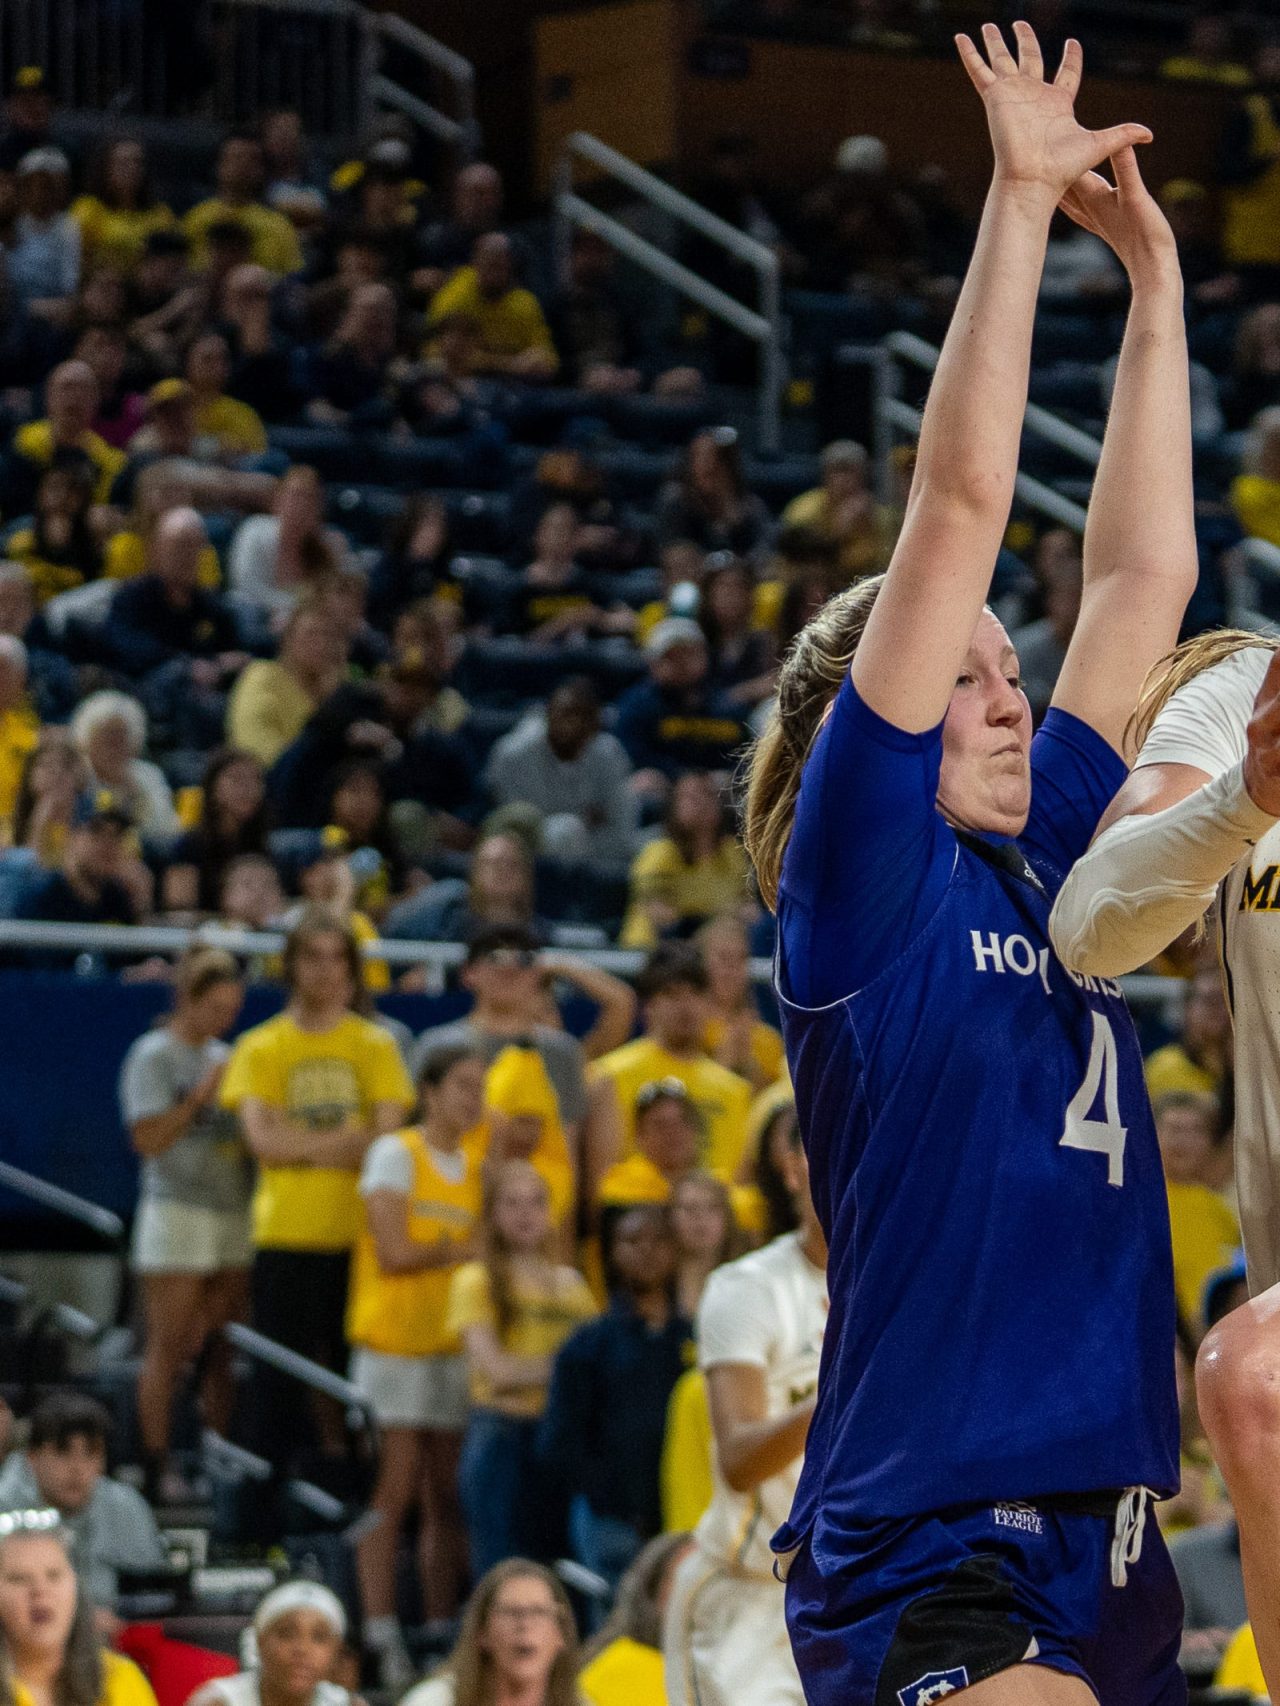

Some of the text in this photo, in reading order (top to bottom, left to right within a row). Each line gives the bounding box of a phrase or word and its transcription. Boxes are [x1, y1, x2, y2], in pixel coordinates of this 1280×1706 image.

[1058, 1009, 1128, 1188] 4
[993, 1507, 1043, 1526] PATRIOT
[995, 1515, 1043, 1535] LEAGUE
